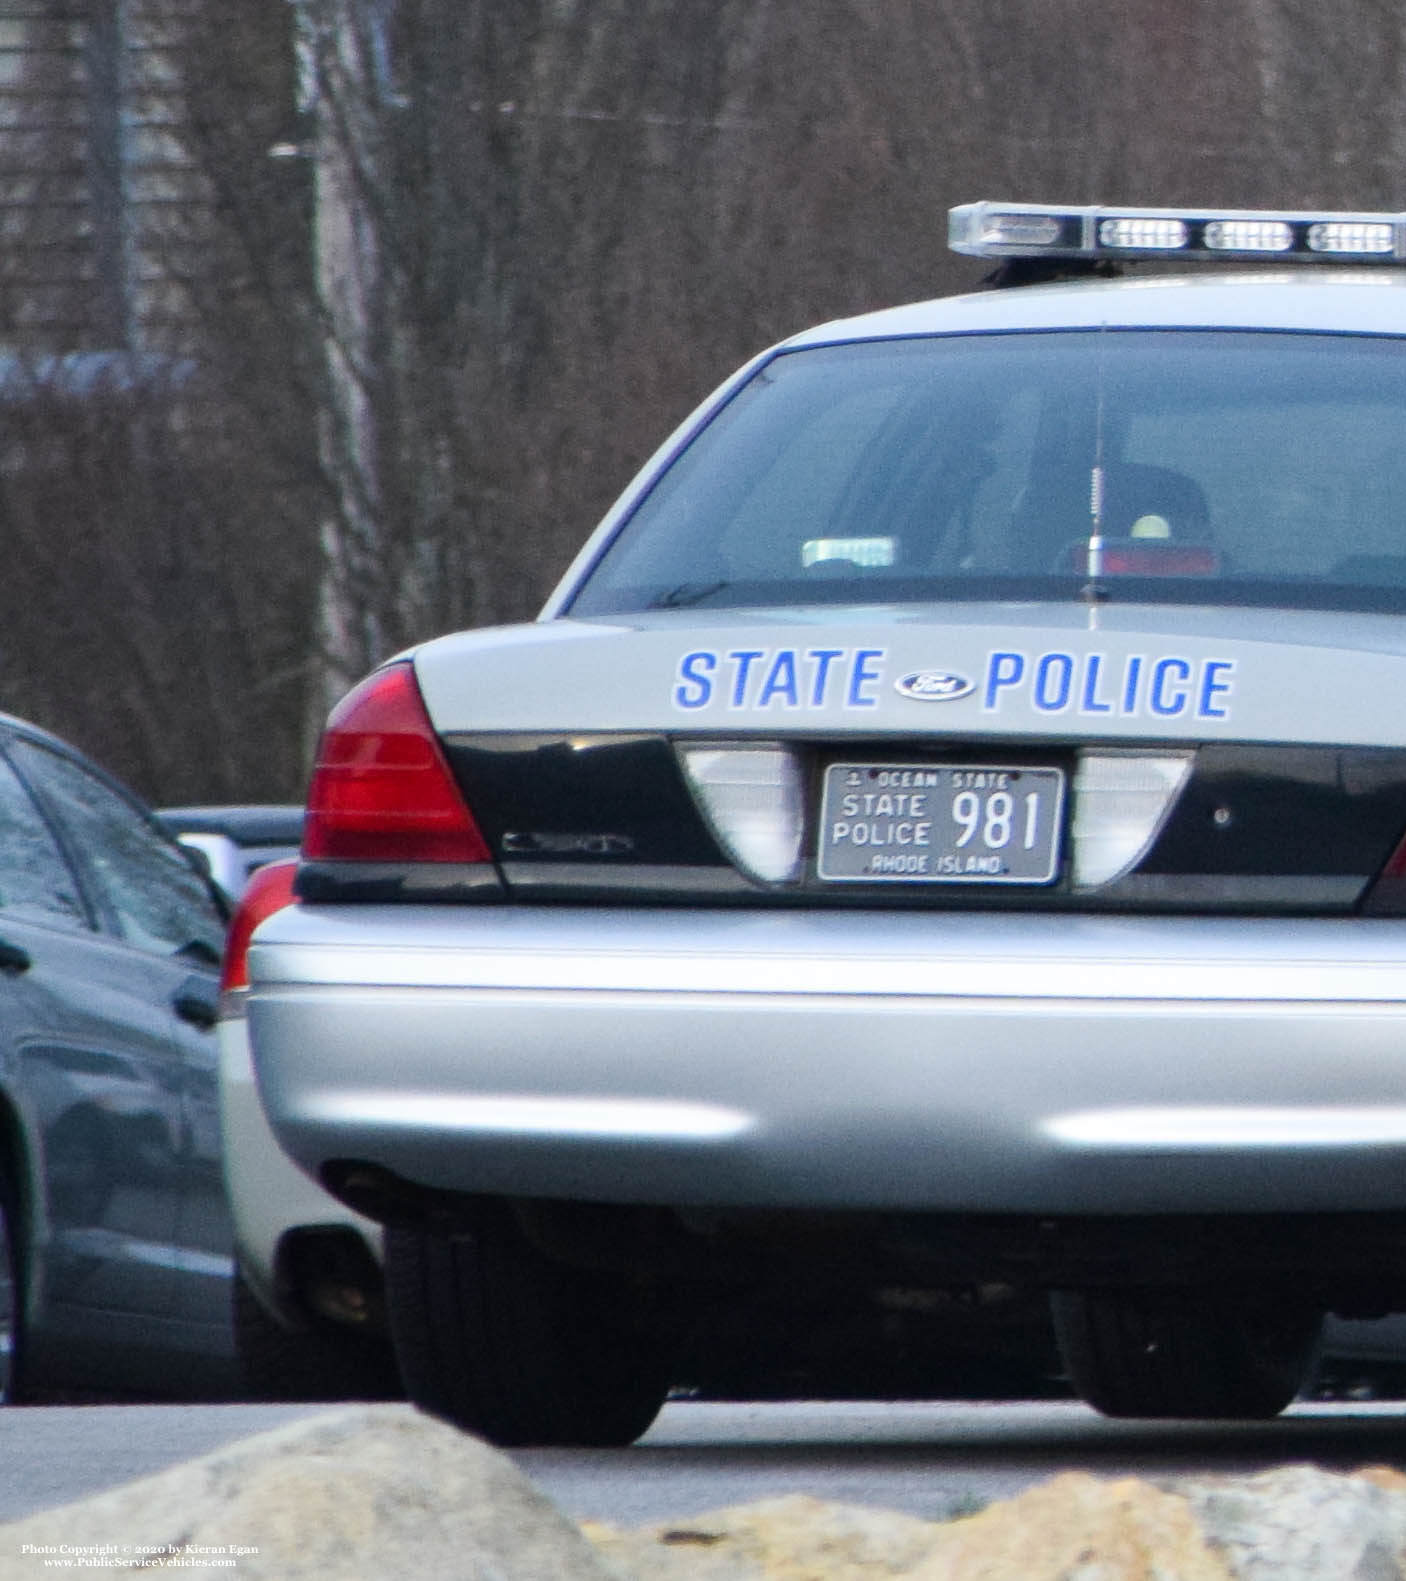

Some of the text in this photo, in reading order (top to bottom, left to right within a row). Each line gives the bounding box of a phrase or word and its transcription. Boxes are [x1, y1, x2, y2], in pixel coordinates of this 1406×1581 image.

[675, 650, 884, 709] STATE
[985, 652, 1234, 718] POLICE
[876, 772, 1008, 790] OCEAN STATE
[842, 794, 928, 817] STATE
[951, 791, 1040, 850] 981
[831, 822, 932, 846] POLICE
[871, 855, 1002, 874] RHODE ISLAND
